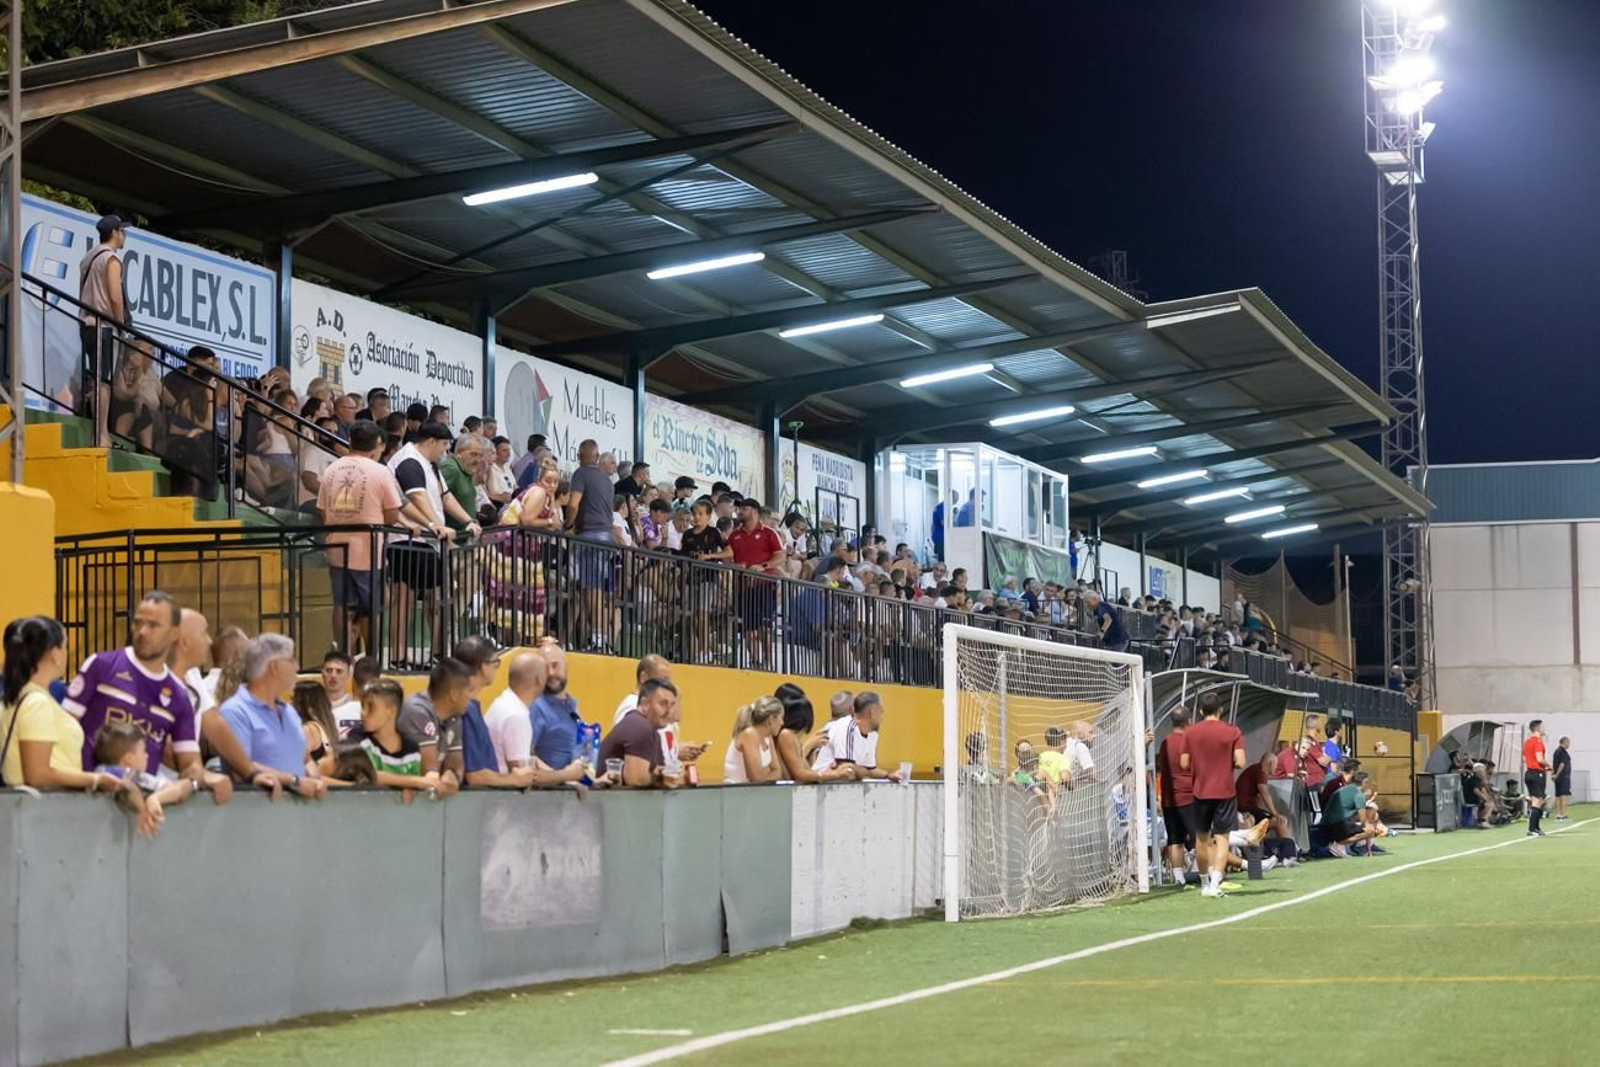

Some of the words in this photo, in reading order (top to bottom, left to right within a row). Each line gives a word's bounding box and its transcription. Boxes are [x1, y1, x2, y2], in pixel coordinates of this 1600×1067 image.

[366, 331, 420, 375] Asociación
[425, 348, 475, 390] Deportiva
[564, 377, 617, 430] Muebles
[661, 414, 704, 458] Rincón
[705, 427, 738, 480] Seba
